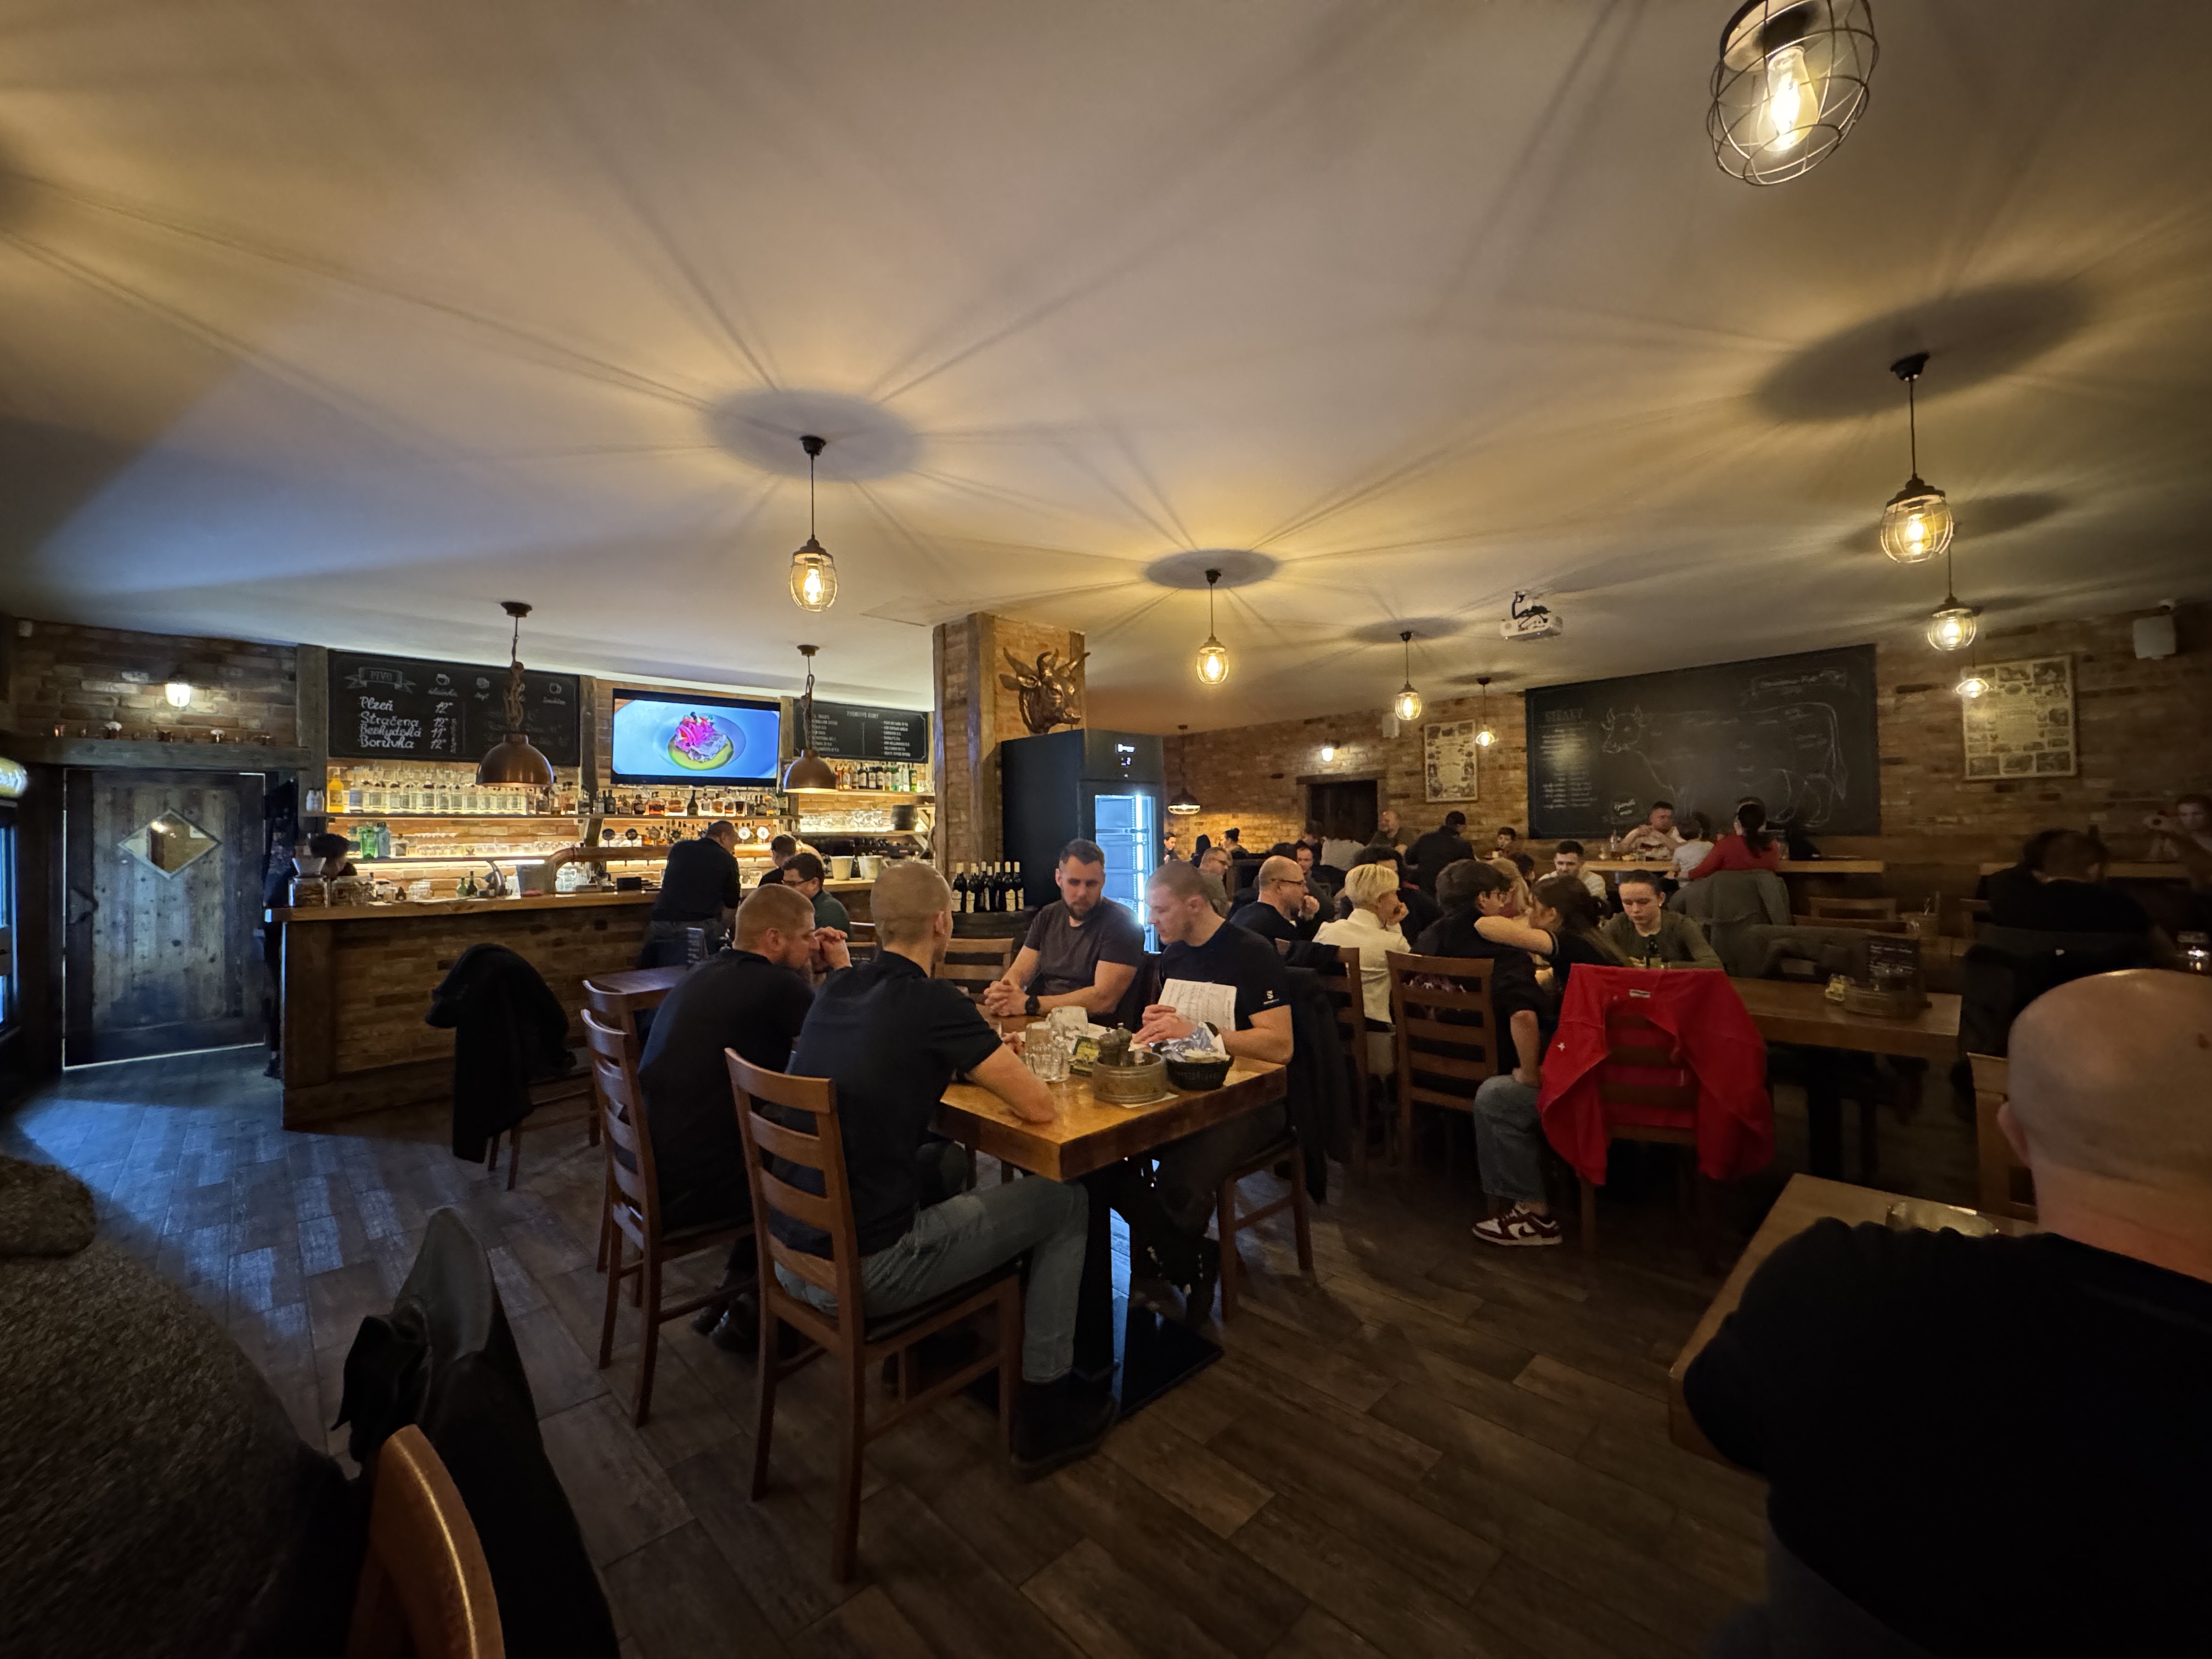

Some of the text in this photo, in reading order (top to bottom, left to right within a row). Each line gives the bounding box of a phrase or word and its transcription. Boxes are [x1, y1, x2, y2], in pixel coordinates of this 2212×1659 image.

[359, 696, 393, 711] Plzeň
[360, 711, 420, 727] Stračena
[1544, 708, 1584, 723] STEAKY
[360, 723, 422, 741] Beskydská
[360, 735, 415, 748] Borůvka
